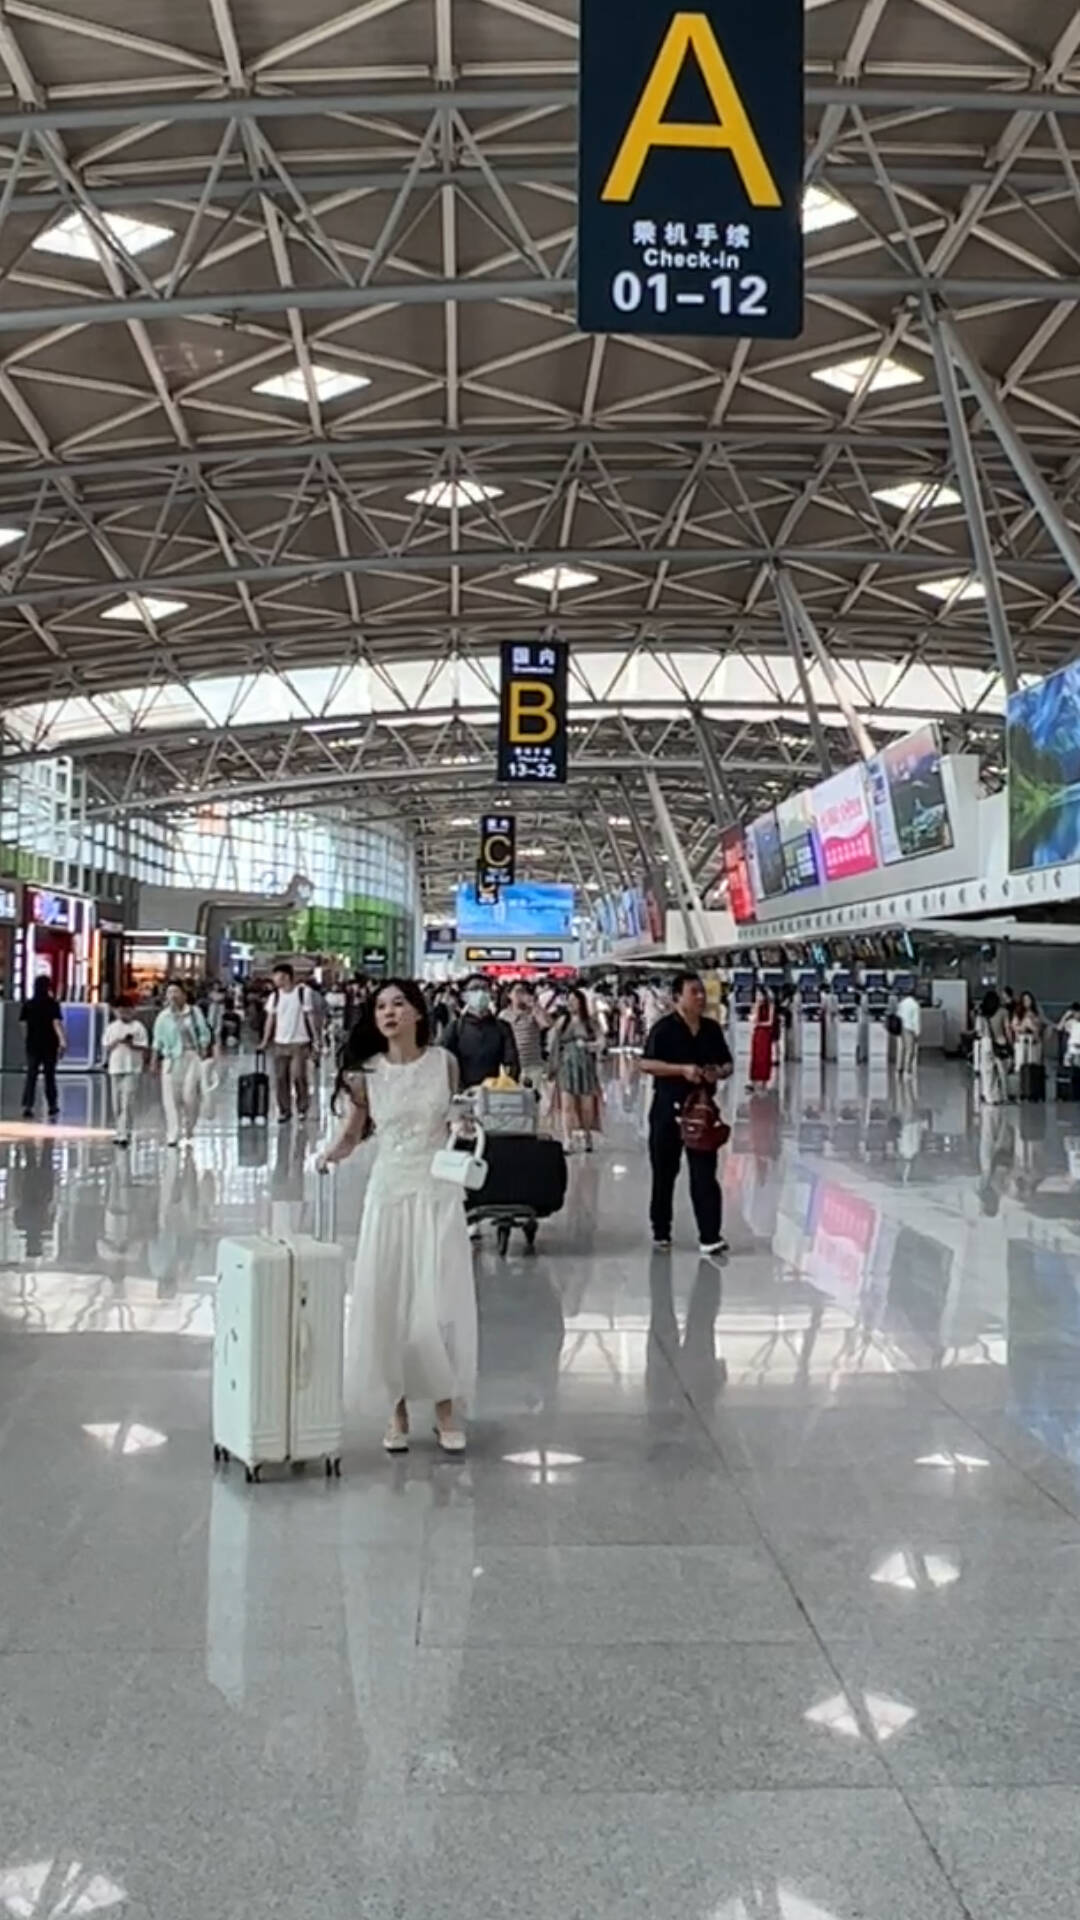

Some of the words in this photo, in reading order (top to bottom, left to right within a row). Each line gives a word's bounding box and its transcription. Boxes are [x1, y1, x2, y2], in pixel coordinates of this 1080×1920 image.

[600, 12, 782, 207] A
[632, 220, 751, 249] 乘机手续
[643, 248, 740, 270] Check-in
[612, 271, 768, 317] 01-12
[509, 681, 557, 743] B
[508, 762, 557, 778] 13-32
[484, 834, 512, 867] C
